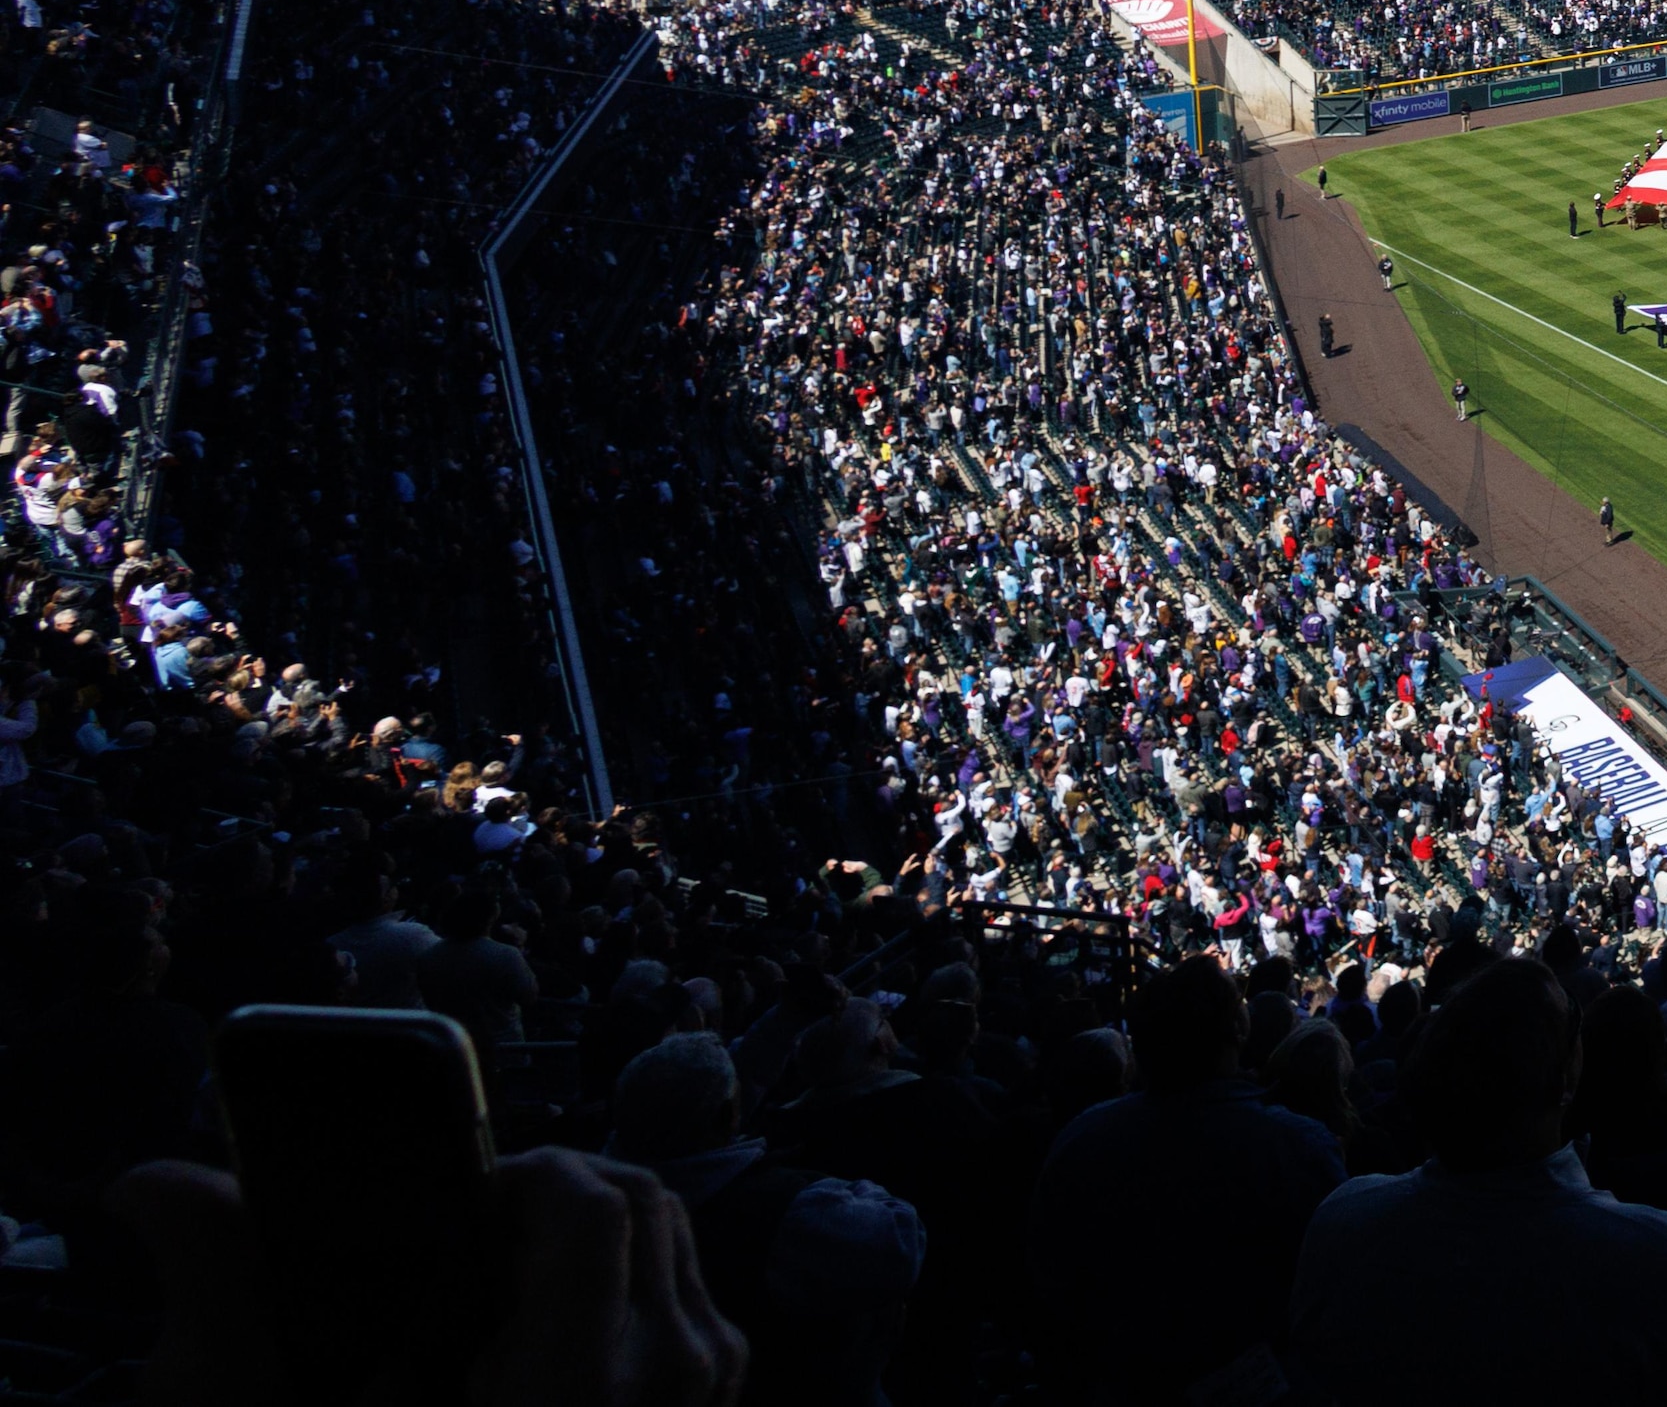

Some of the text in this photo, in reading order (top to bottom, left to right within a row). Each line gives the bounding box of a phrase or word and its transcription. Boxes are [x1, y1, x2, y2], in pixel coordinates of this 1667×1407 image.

[1629, 63, 1656, 75] MLB+
[1503, 80, 1559, 97] Huntington Bank
[1374, 97, 1446, 117] xfinity mobile
